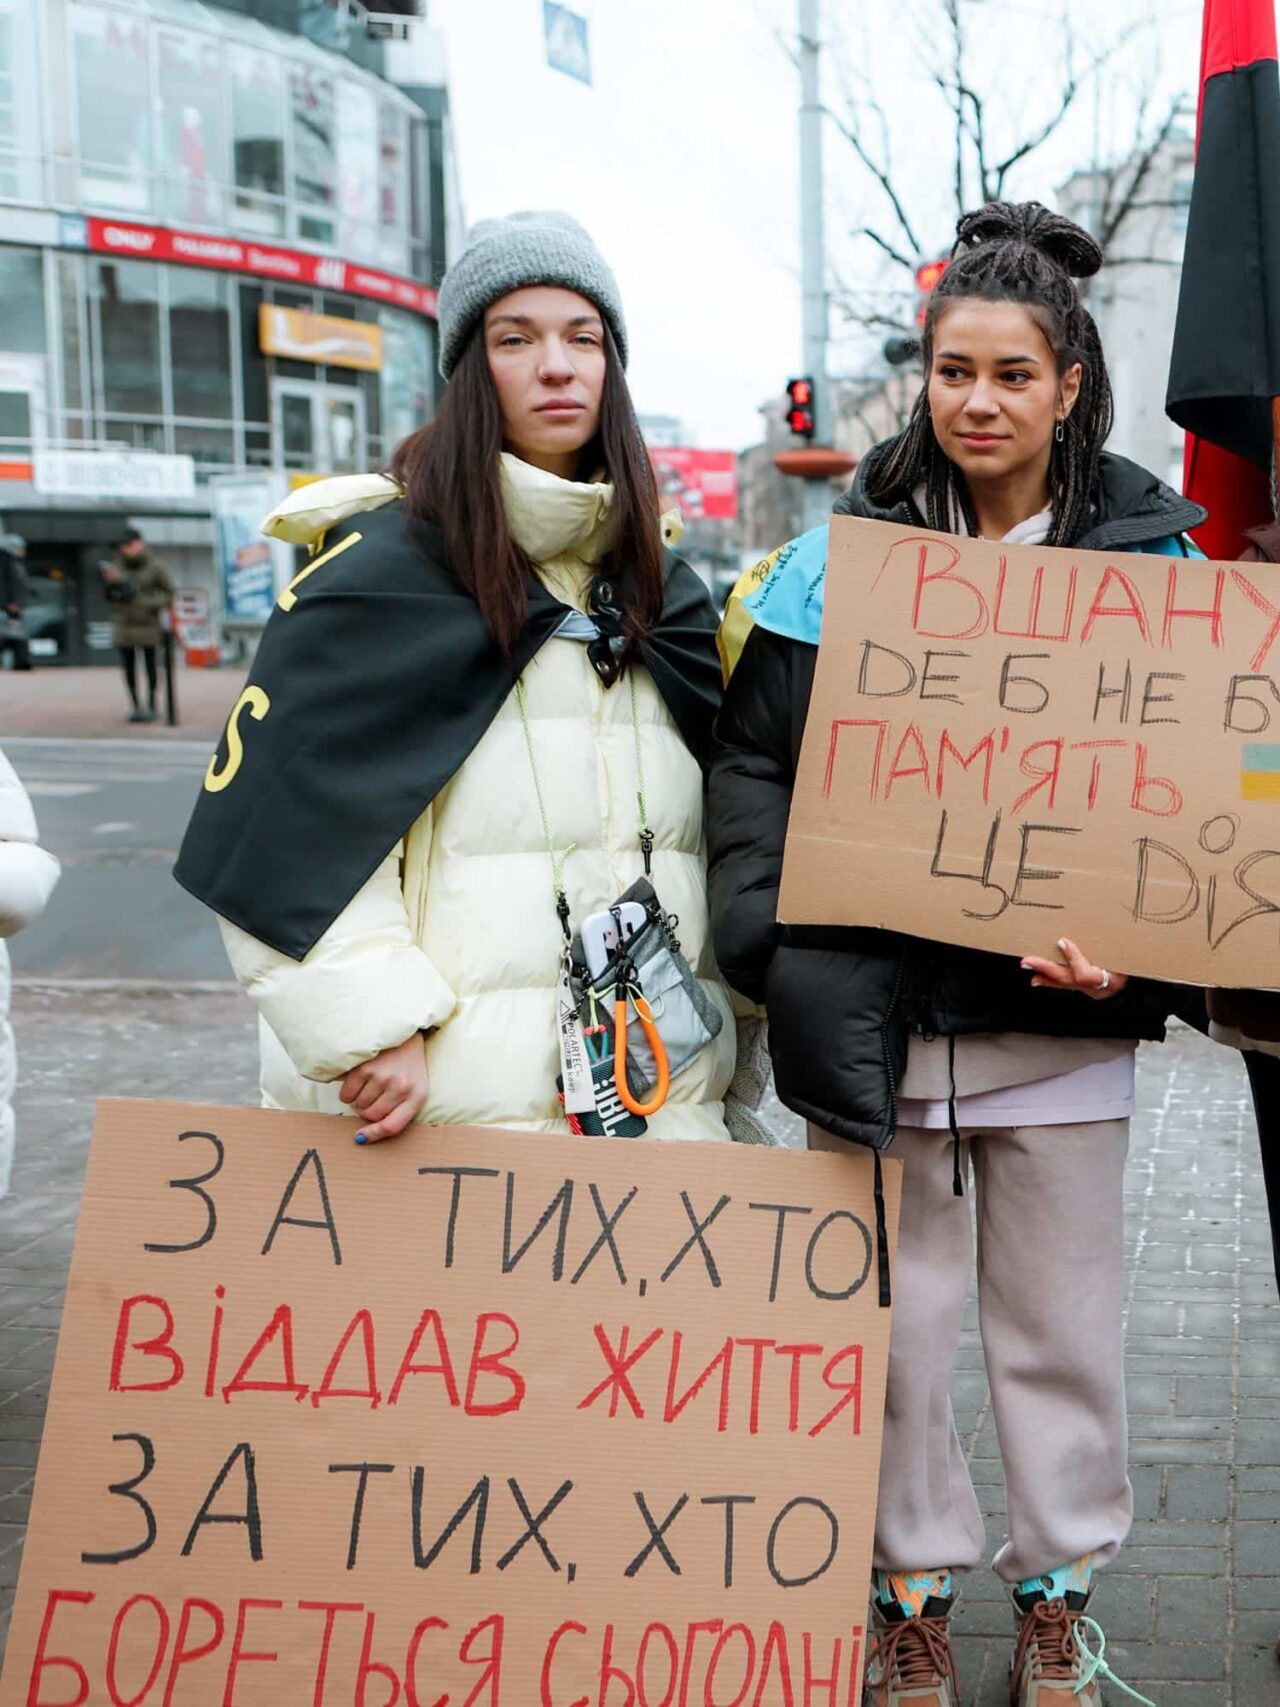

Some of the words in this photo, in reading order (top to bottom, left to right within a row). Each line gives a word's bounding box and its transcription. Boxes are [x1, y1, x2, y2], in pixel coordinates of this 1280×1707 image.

[1093, 658, 1186, 724] НЕ
[930, 807, 1082, 920] ЦЕ
[143, 1130, 342, 1266] ЗА
[660, 1190, 874, 1302] ХТО
[577, 1324, 863, 1438] ЖИТТЯ
[80, 1432, 264, 1564] ЗА
[328, 1461, 578, 1582] ТИХ,
[624, 1491, 840, 1589] ХТО
